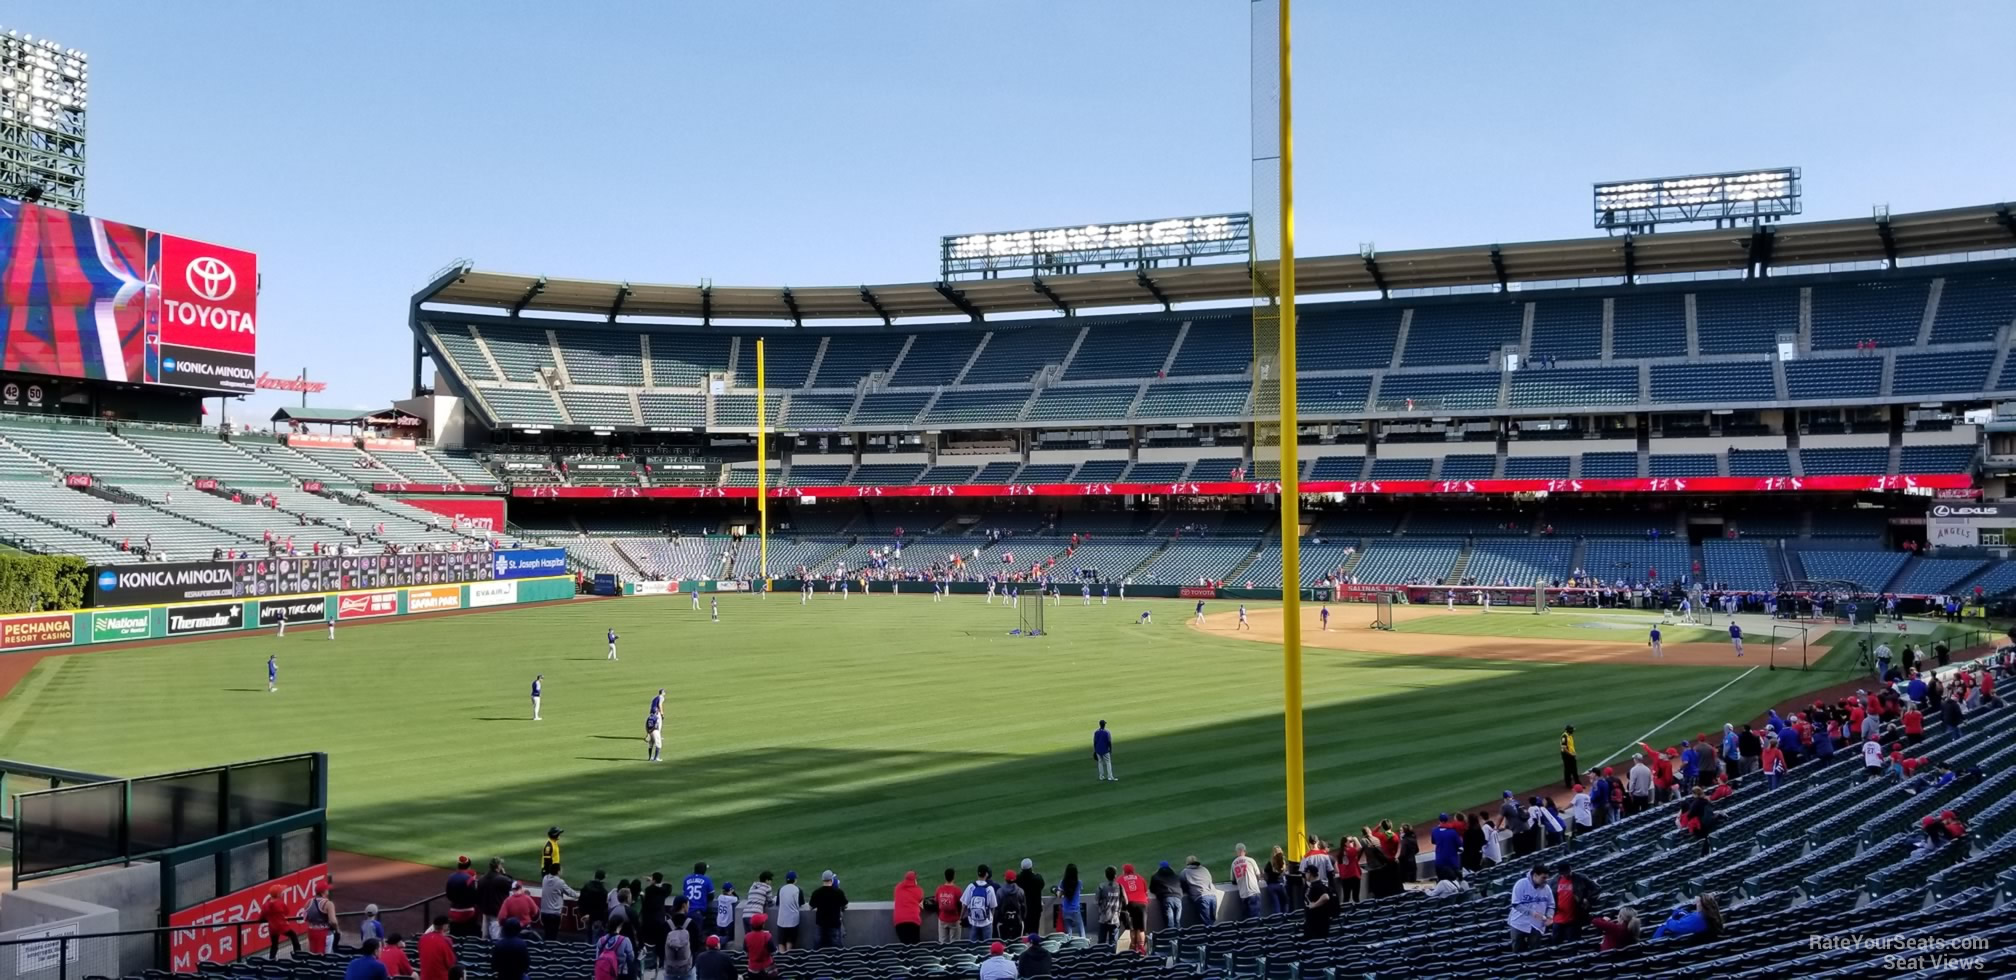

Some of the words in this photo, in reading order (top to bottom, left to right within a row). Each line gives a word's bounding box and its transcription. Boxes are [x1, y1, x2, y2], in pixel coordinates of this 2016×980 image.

[163, 299, 255, 335] TOYOTA
[176, 360, 214, 375] KONICA
[215, 365, 254, 380] MINOLTA
[5, 386, 18, 397] 42
[29, 388, 41, 399] 50
[1951, 507, 1998, 515] LEXUS
[455, 513, 493, 530] Farm
[1937, 527, 1971, 539] ANGELS
[247, 563, 253, 573] 3
[269, 562, 275, 572] 6
[292, 561, 297, 571] 1
[312, 560, 318, 570] 7
[333, 559, 338, 569] 1
[352, 558, 358, 568] 4
[371, 558, 377, 567] 5
[390, 557, 395, 566] 5
[407, 557, 412, 565] 6
[424, 556, 429, 564] 6
[509, 560, 517, 569] St.
[518, 558, 541, 570] Joseph
[541, 557, 565, 569] Hospital
[119, 571, 175, 589] KONICA
[176, 568, 233, 585] MINOLTA
[245, 584, 255, 594] 10
[270, 583, 275, 593] 1
[290, 581, 298, 591] 11
[312, 580, 318, 590] 4
[352, 578, 357, 587] 6
[371, 577, 376, 586] 3
[390, 575, 394, 583] 1
[407, 575, 411, 583] 2
[476, 589, 490, 597] EVA
[490, 588, 503, 596] AIR
[288, 602, 324, 616] TIRE.COM
[411, 597, 437, 610] SAFARI
[438, 596, 458, 607] PARK
[5, 620, 70, 636] PECHANGA
[107, 616, 148, 630] National
[170, 613, 230, 630] Thermador
[5, 634, 37, 644] RESORT
[41, 630, 72, 641] CASINO
[1234, 863, 1248, 879] 27
[687, 885, 703, 900] 35
[173, 875, 325, 947] INTERATIVE
[719, 905, 728, 915] 66
